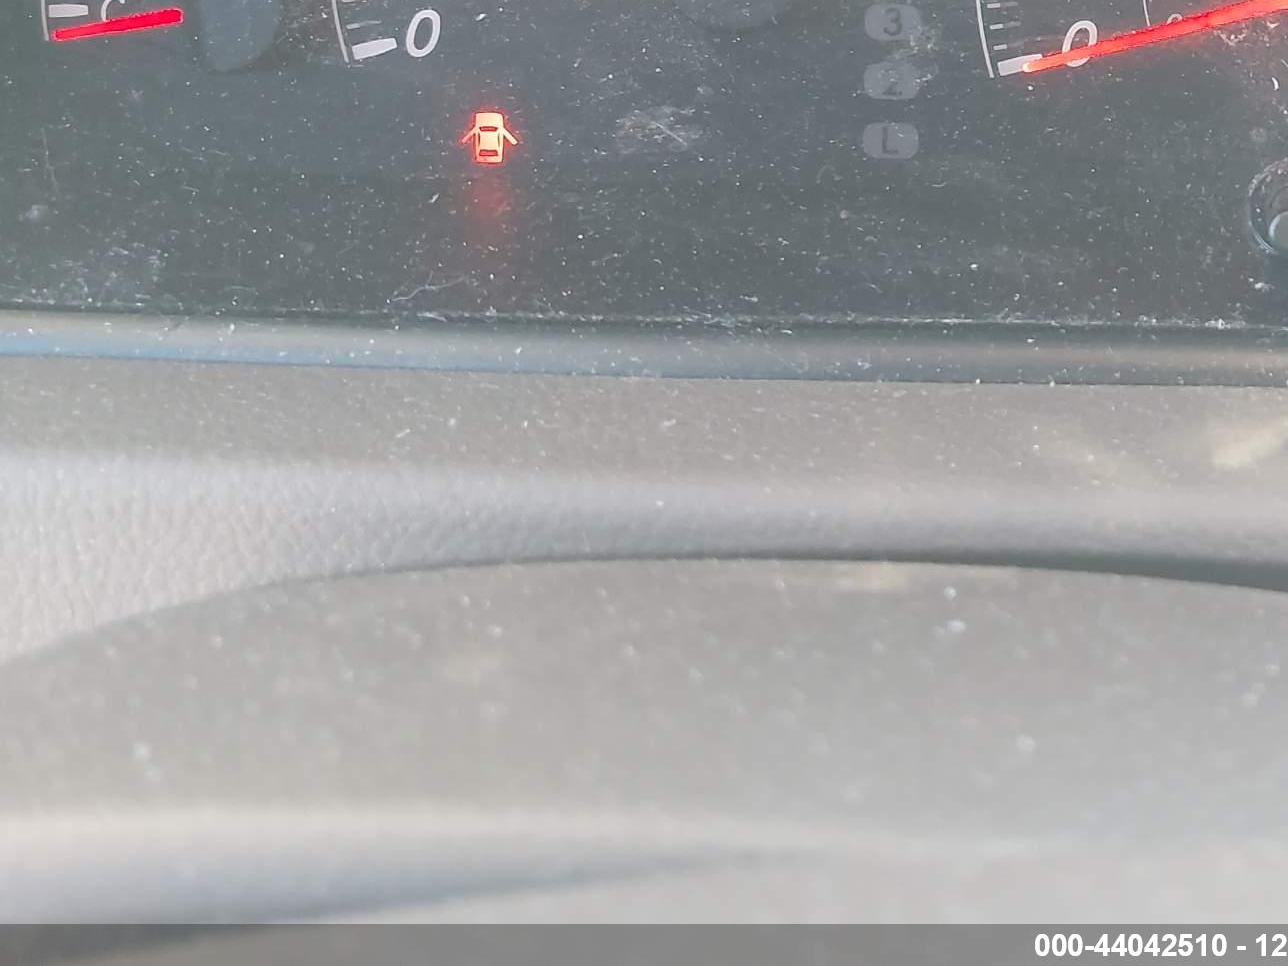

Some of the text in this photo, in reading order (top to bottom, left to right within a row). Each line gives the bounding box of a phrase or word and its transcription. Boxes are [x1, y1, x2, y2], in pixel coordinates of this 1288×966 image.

[405, 9, 441, 58] 0
[883, 9, 903, 38] 3
[1061, 20, 1098, 68] 0
[881, 126, 900, 155] L
